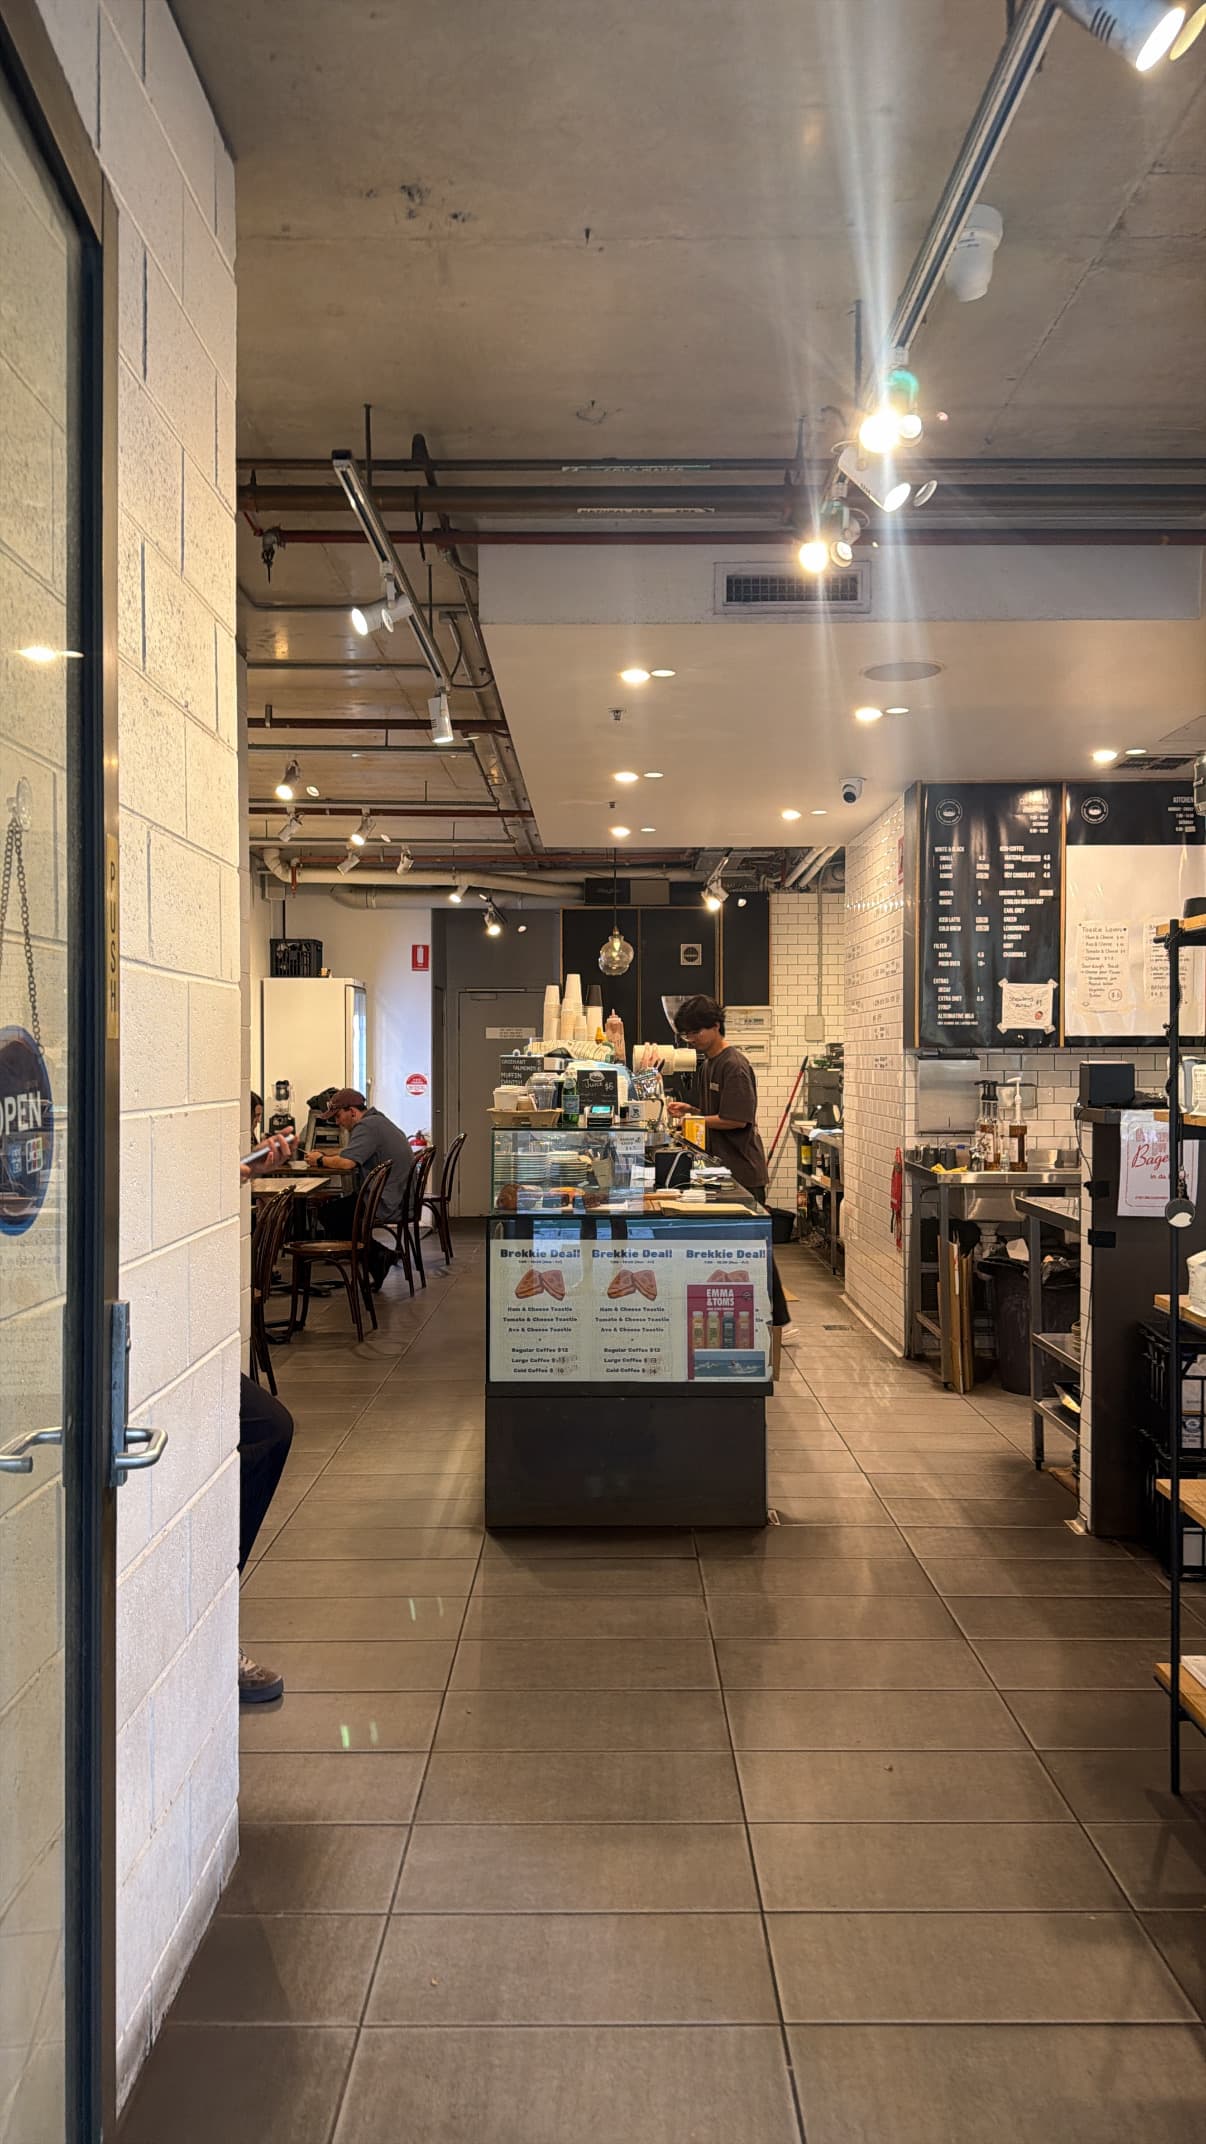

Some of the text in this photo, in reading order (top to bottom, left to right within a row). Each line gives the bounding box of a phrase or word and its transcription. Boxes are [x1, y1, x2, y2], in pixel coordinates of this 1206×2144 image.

[1131, 1144, 1169, 1171] Bage
[500, 1249, 580, 1258] Brekkie Deal!
[592, 1249, 672, 1258] Brekkie Deal!
[686, 1249, 766, 1258] Brekkie Deal!
[706, 1288, 734, 1297] EMMA
[706, 1297, 734, 1306] &TOMS
